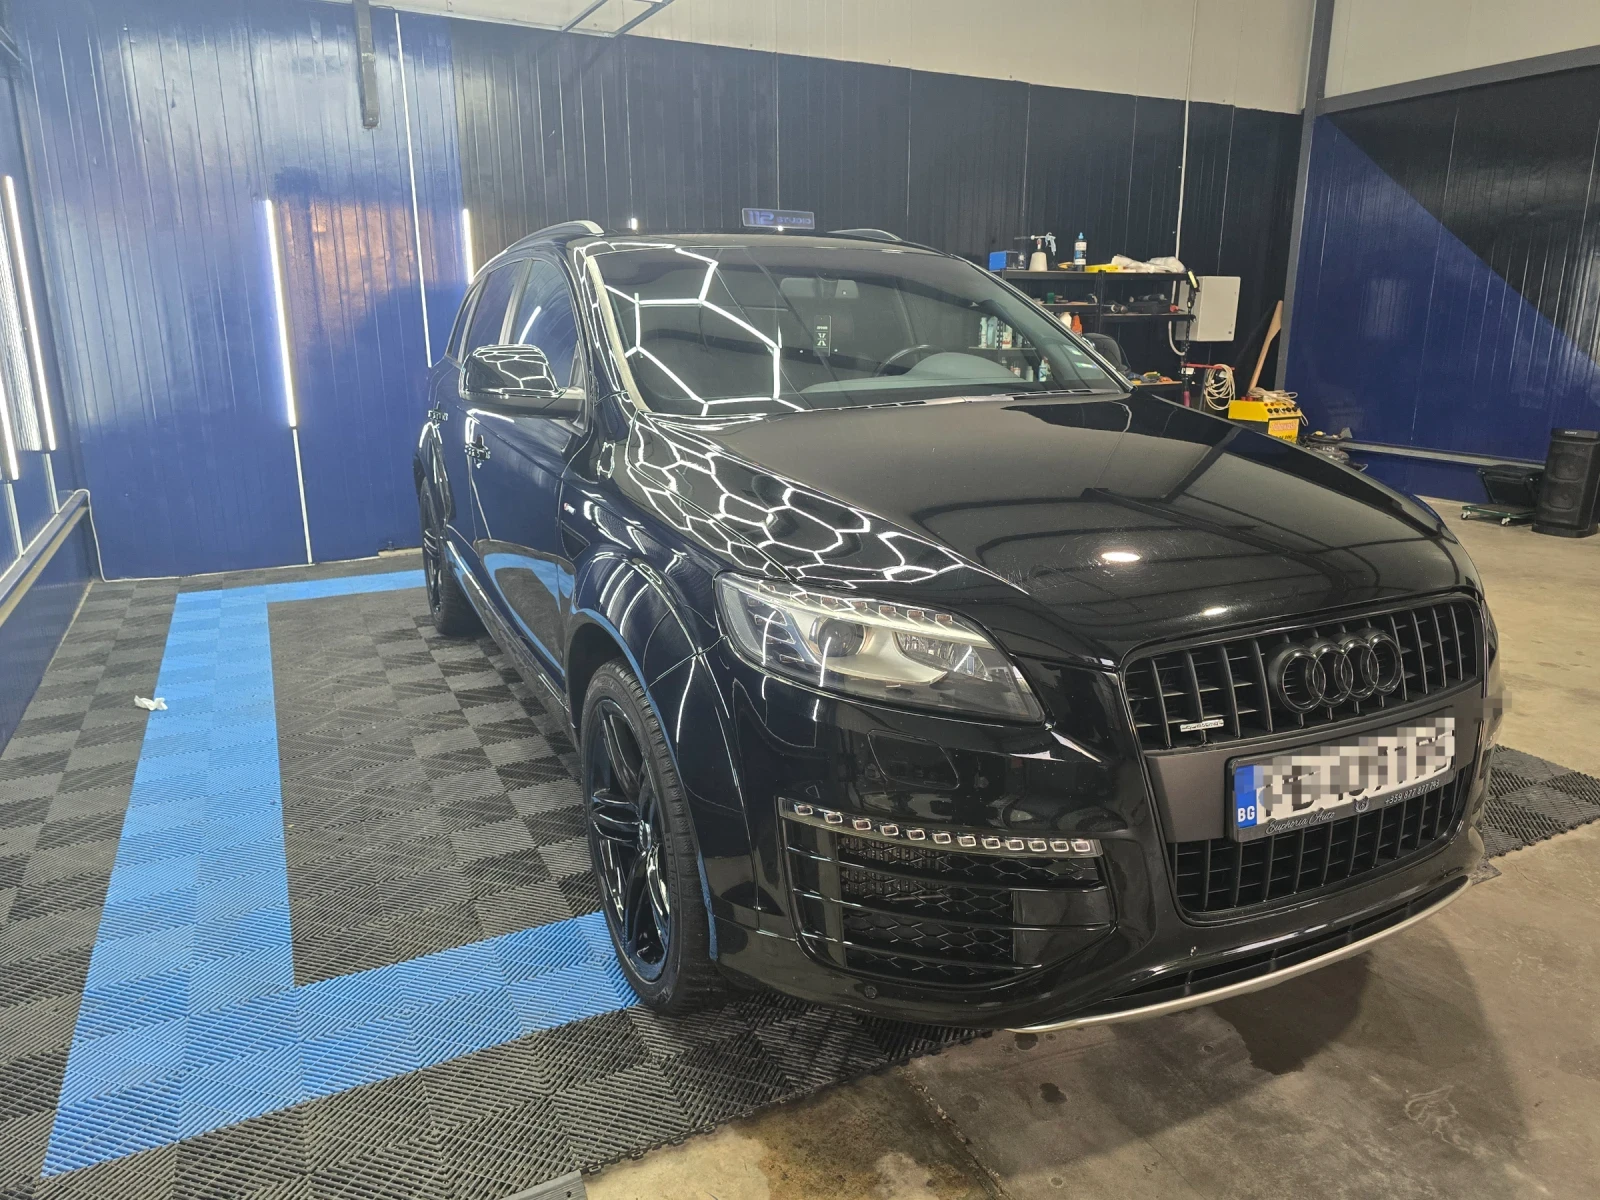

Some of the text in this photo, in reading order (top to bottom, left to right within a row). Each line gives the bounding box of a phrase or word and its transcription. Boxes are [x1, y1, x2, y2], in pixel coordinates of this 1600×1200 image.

[777, 216, 812, 225] STUDIO
[1385, 793, 1403, 804] +359
[1404, 788, 1416, 800] 877
[1417, 784, 1429, 795] 877
[1237, 805, 1256, 822] BG
[1266, 810, 1335, 834] Euphoria Auto
